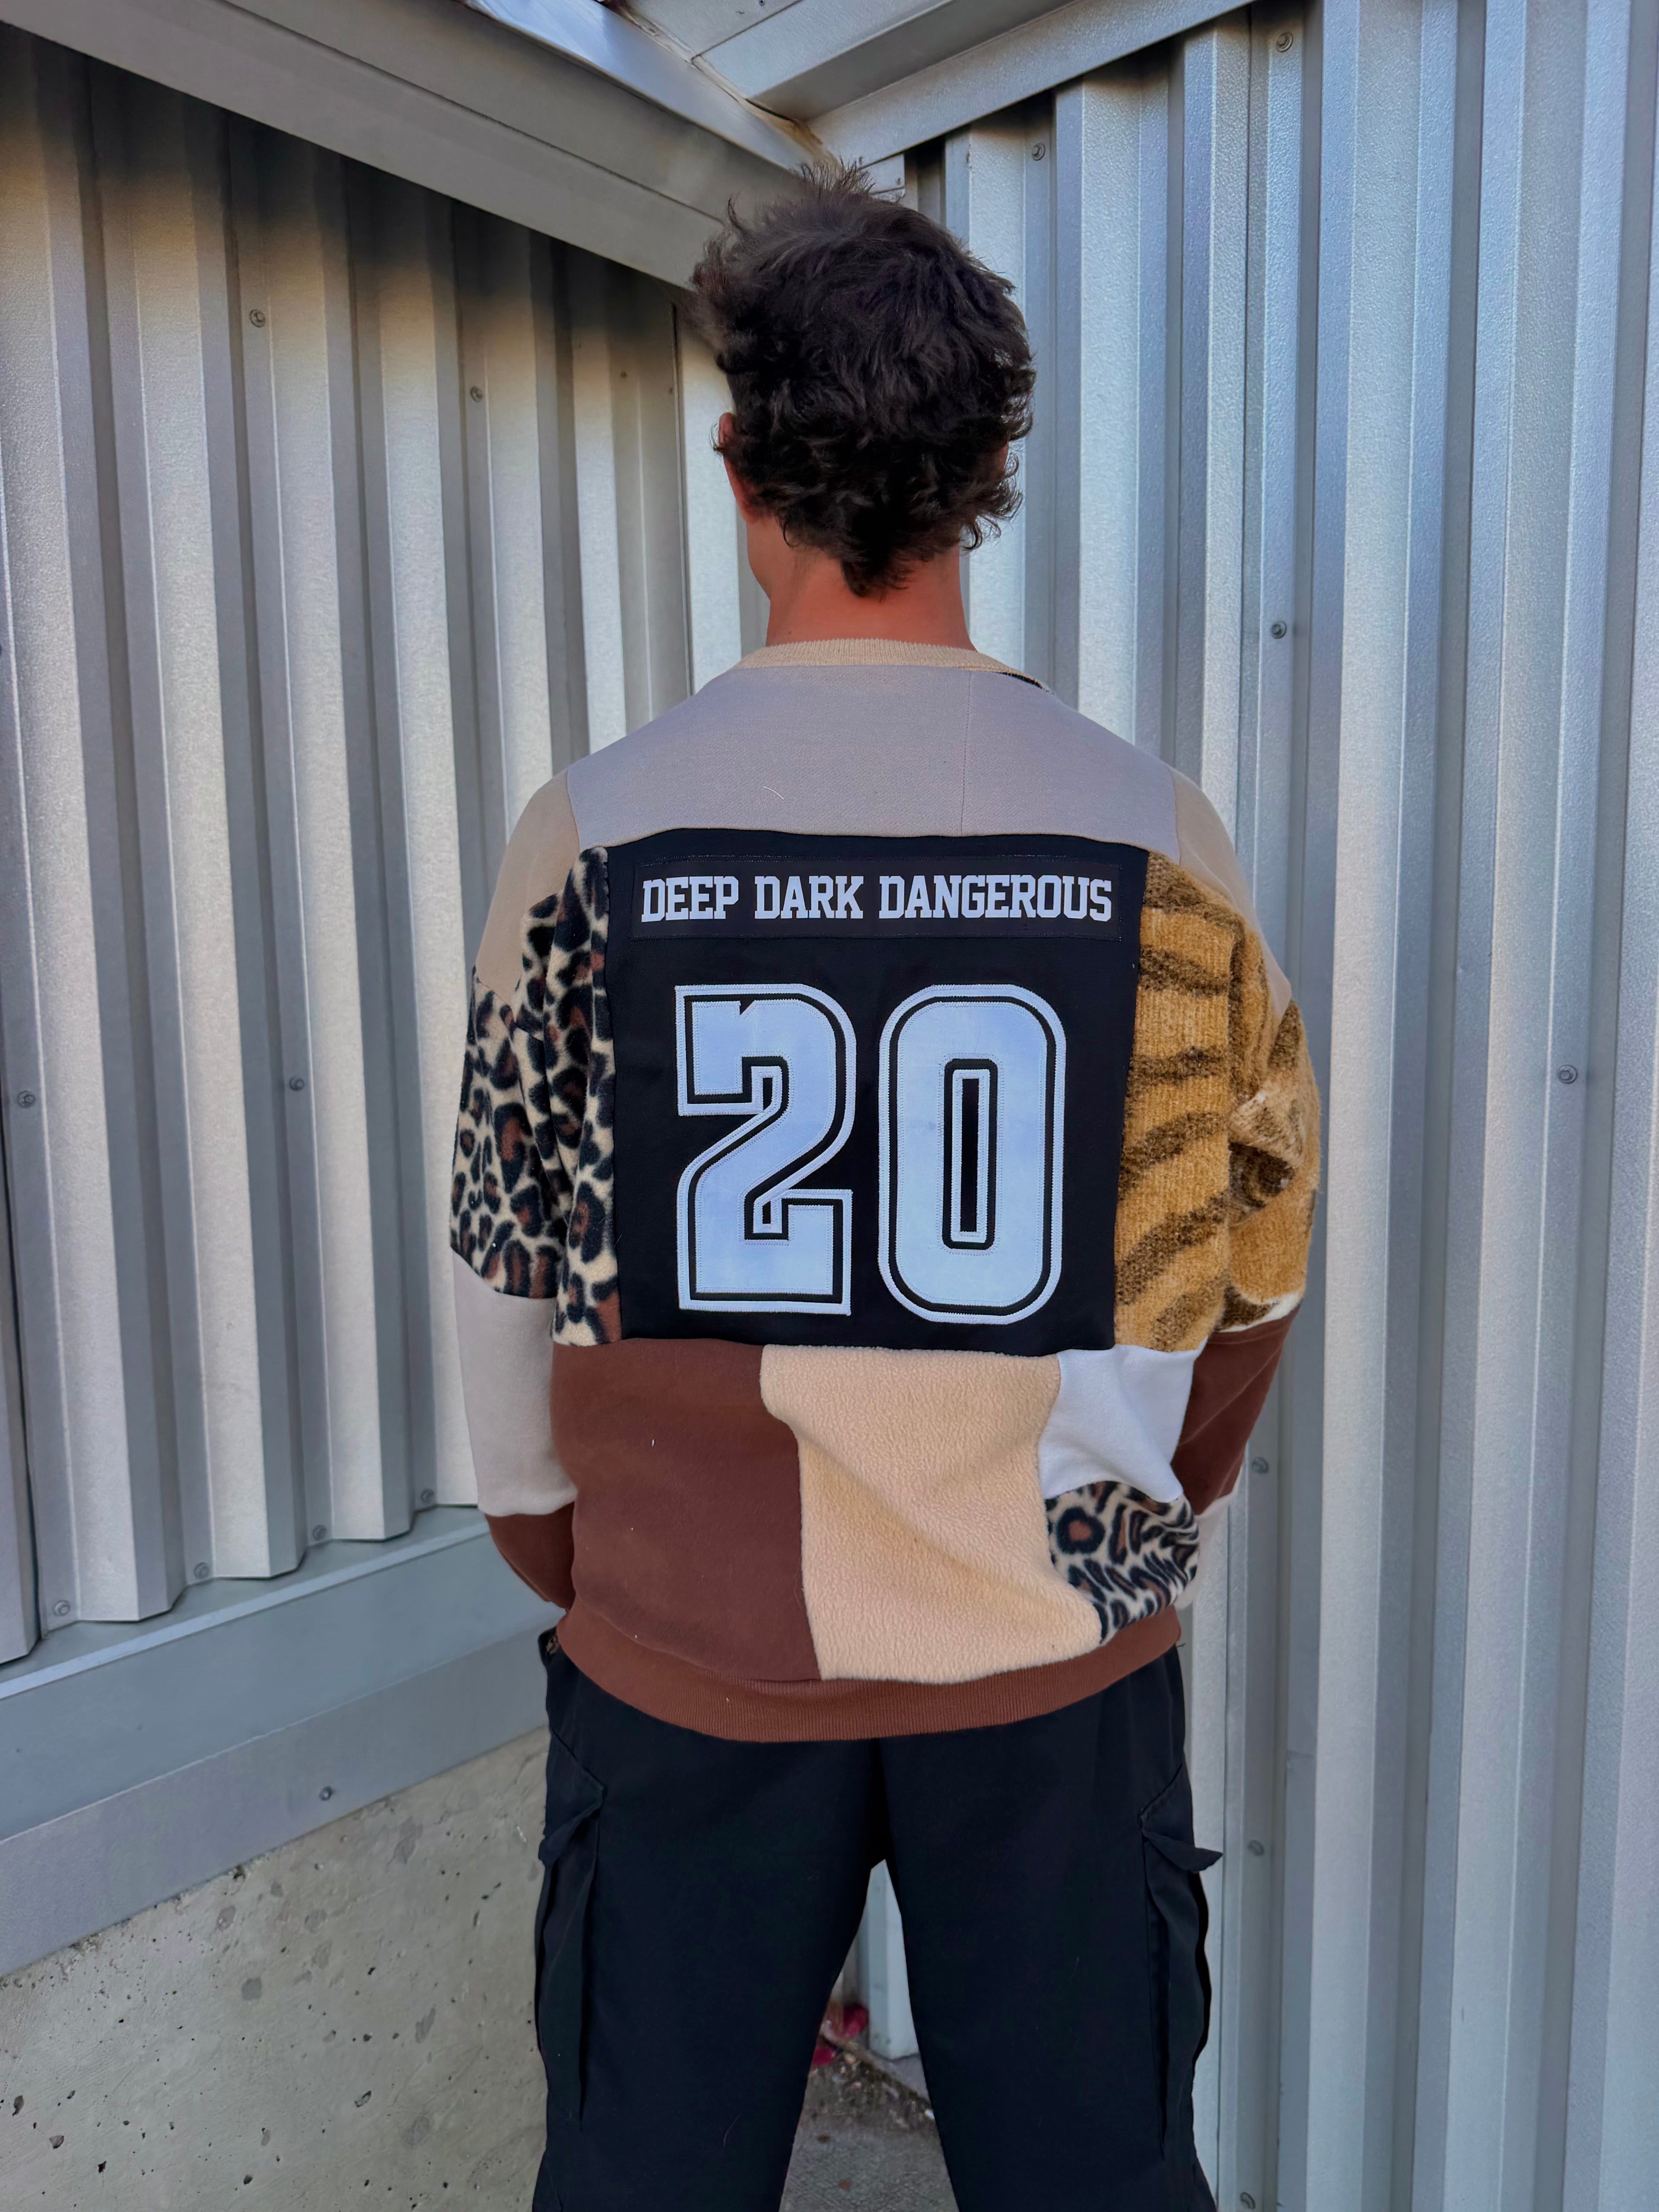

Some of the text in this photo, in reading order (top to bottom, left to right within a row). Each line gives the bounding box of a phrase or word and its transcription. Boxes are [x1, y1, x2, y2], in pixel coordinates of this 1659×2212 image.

[642, 874, 1112, 922] DEEP DARK DANGEROUS
[674, 984, 1066, 1324] 20
